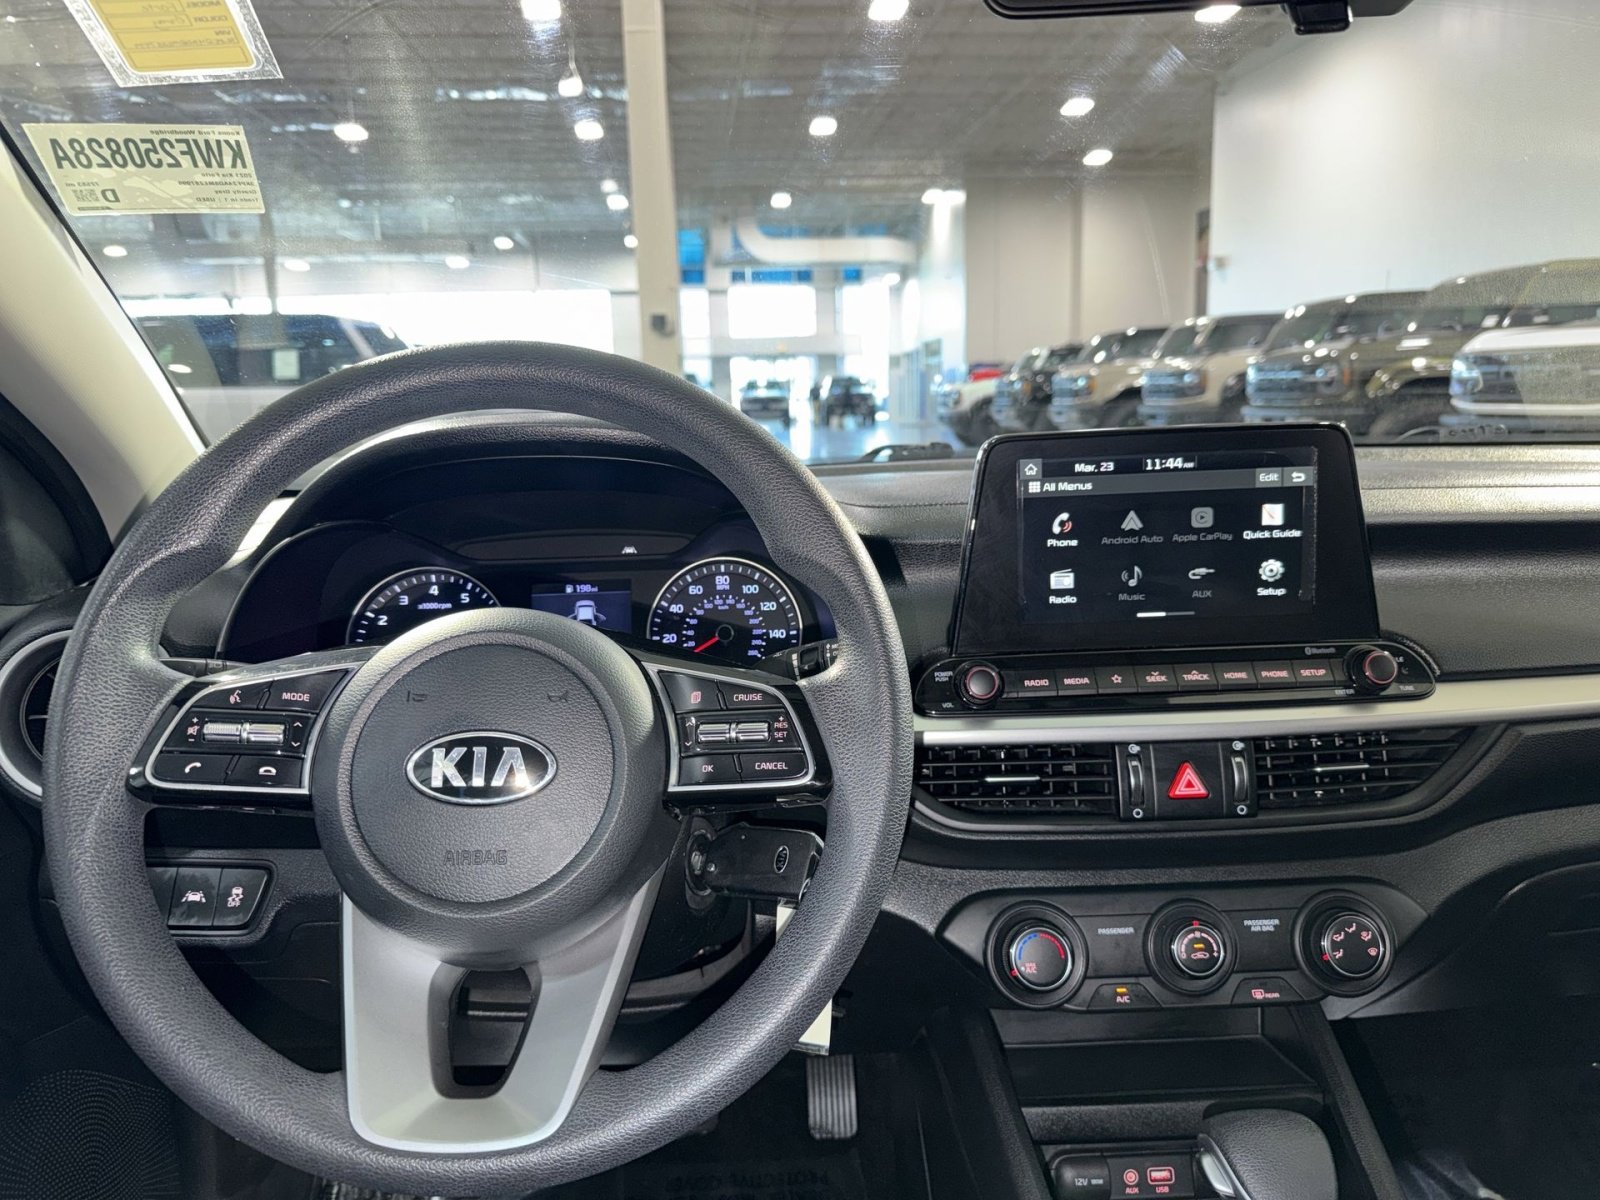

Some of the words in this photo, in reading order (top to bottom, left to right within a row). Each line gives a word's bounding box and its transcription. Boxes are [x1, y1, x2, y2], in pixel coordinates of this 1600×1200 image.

[1074, 462, 1098, 473] Mar.
[1100, 462, 1114, 472] 23
[1259, 472, 1279, 482] Edit
[1043, 482, 1056, 492] All
[1057, 481, 1093, 491] Menus
[1101, 534, 1138, 545] Android
[1140, 533, 1163, 543] Auto
[1172, 532, 1198, 543] Apple
[1199, 531, 1233, 542] CarPlay
[1243, 529, 1271, 540] Quick
[1272, 529, 1302, 539] Guide
[1047, 537, 1078, 548] Phone
[715, 575, 730, 585] 80
[428, 585, 439, 596] 4
[688, 585, 703, 595] 60
[742, 585, 759, 594] 100
[1192, 589, 1212, 599] AUX
[1256, 586, 1286, 597] Setup
[399, 595, 409, 606] 3
[460, 593, 470, 604] 5
[1049, 594, 1077, 605] Radio
[1118, 591, 1146, 602] Music
[669, 604, 684, 613] 40
[760, 602, 777, 611] 120
[377, 615, 388, 626] 2
[662, 634, 677, 644] 20
[768, 629, 786, 639] 140
[1182, 673, 1209, 681] TRACK
[1223, 671, 1248, 679] HOME
[1261, 670, 1289, 678] PHONE
[1300, 669, 1326, 677] SETUP
[1024, 679, 1049, 687] RADIO
[1063, 677, 1090, 685] MEDIA
[1146, 675, 1167, 683] SEEK
[282, 692, 310, 702] MODE
[733, 693, 763, 702] CRUISE
[431, 746, 531, 788] KIA
[702, 765, 714, 773] OK
[755, 762, 788, 770] CANCEL
[443, 849, 508, 866] AIRBAG
[227, 900, 241, 908] OFF
[1244, 918, 1280, 926] PASSENGER
[1097, 926, 1135, 935] PASSENGER
[1116, 995, 1130, 1003] A/C
[1075, 1178, 1088, 1186] 12V
